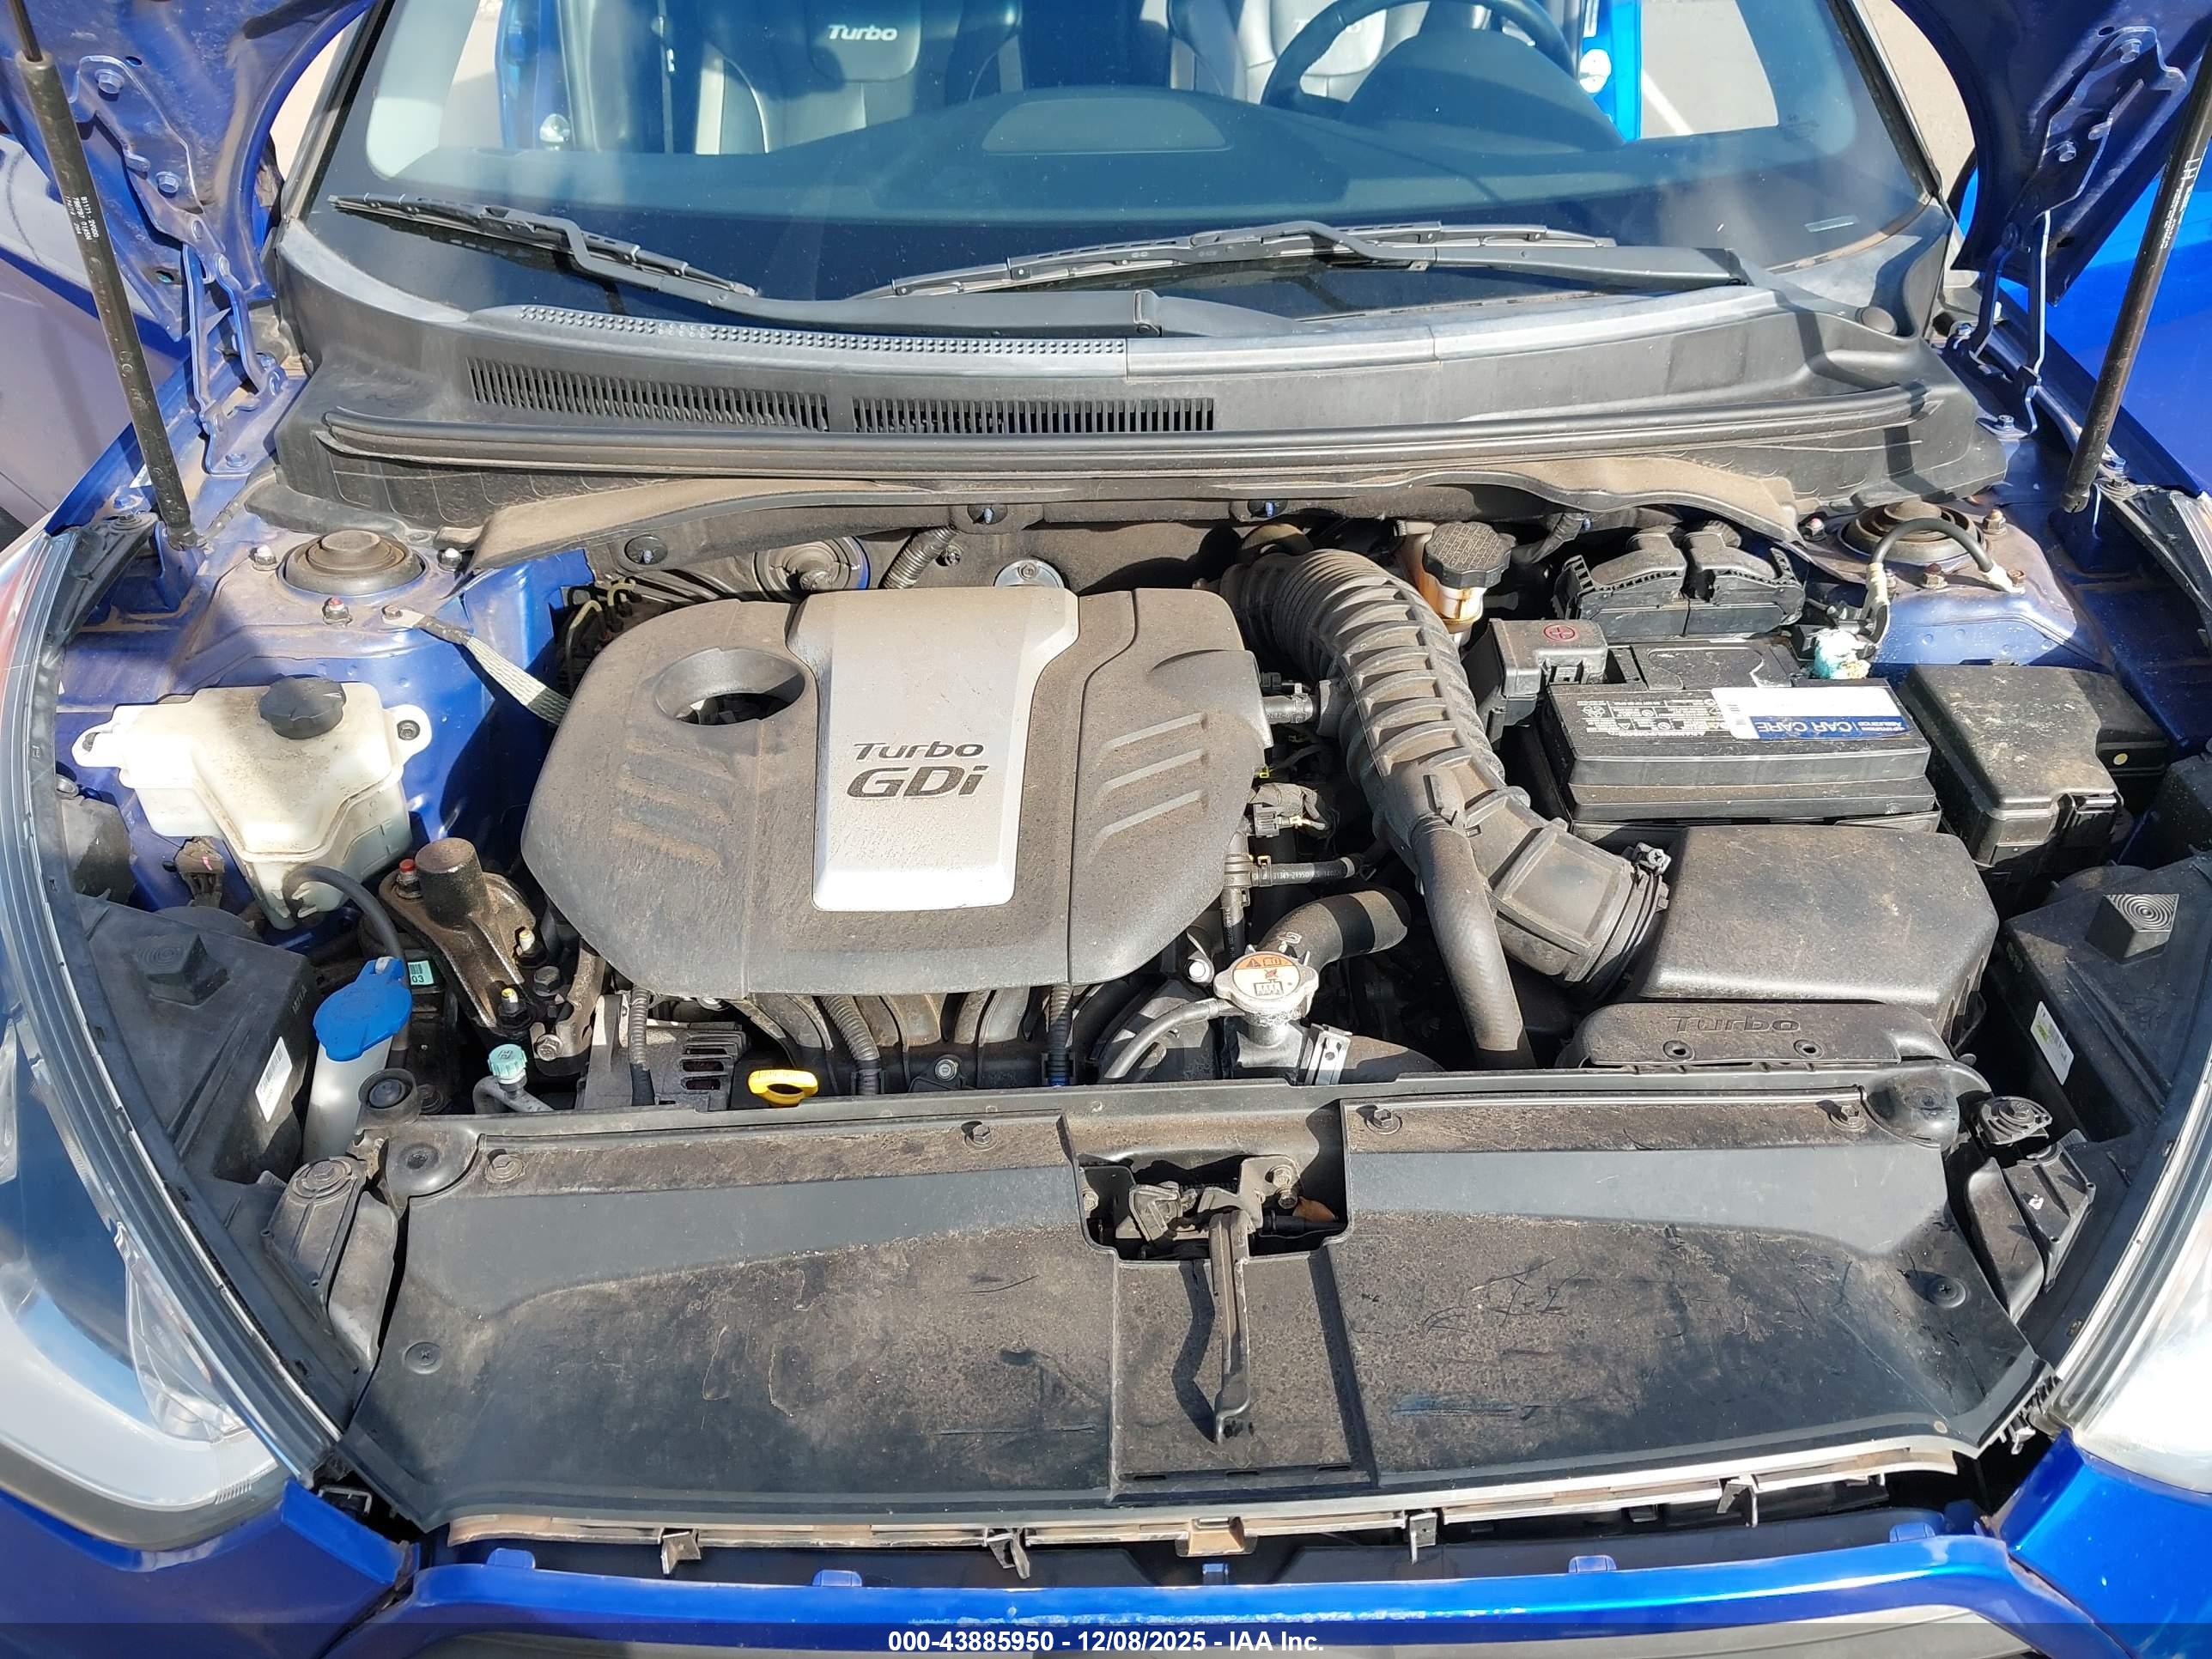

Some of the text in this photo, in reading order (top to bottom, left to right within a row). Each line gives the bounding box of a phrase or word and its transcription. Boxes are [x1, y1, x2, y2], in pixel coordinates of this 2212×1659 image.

[828, 24, 898, 41] Turbo
[2180, 157, 2201, 180] LH
[1754, 721, 1854, 732] CAR CARE
[854, 740, 985, 762] Turbo
[846, 765, 989, 798] GDi
[412, 975, 425, 983] 03
[1667, 1016, 1802, 1032] Turbo
[498, 1049, 513, 1060] H
